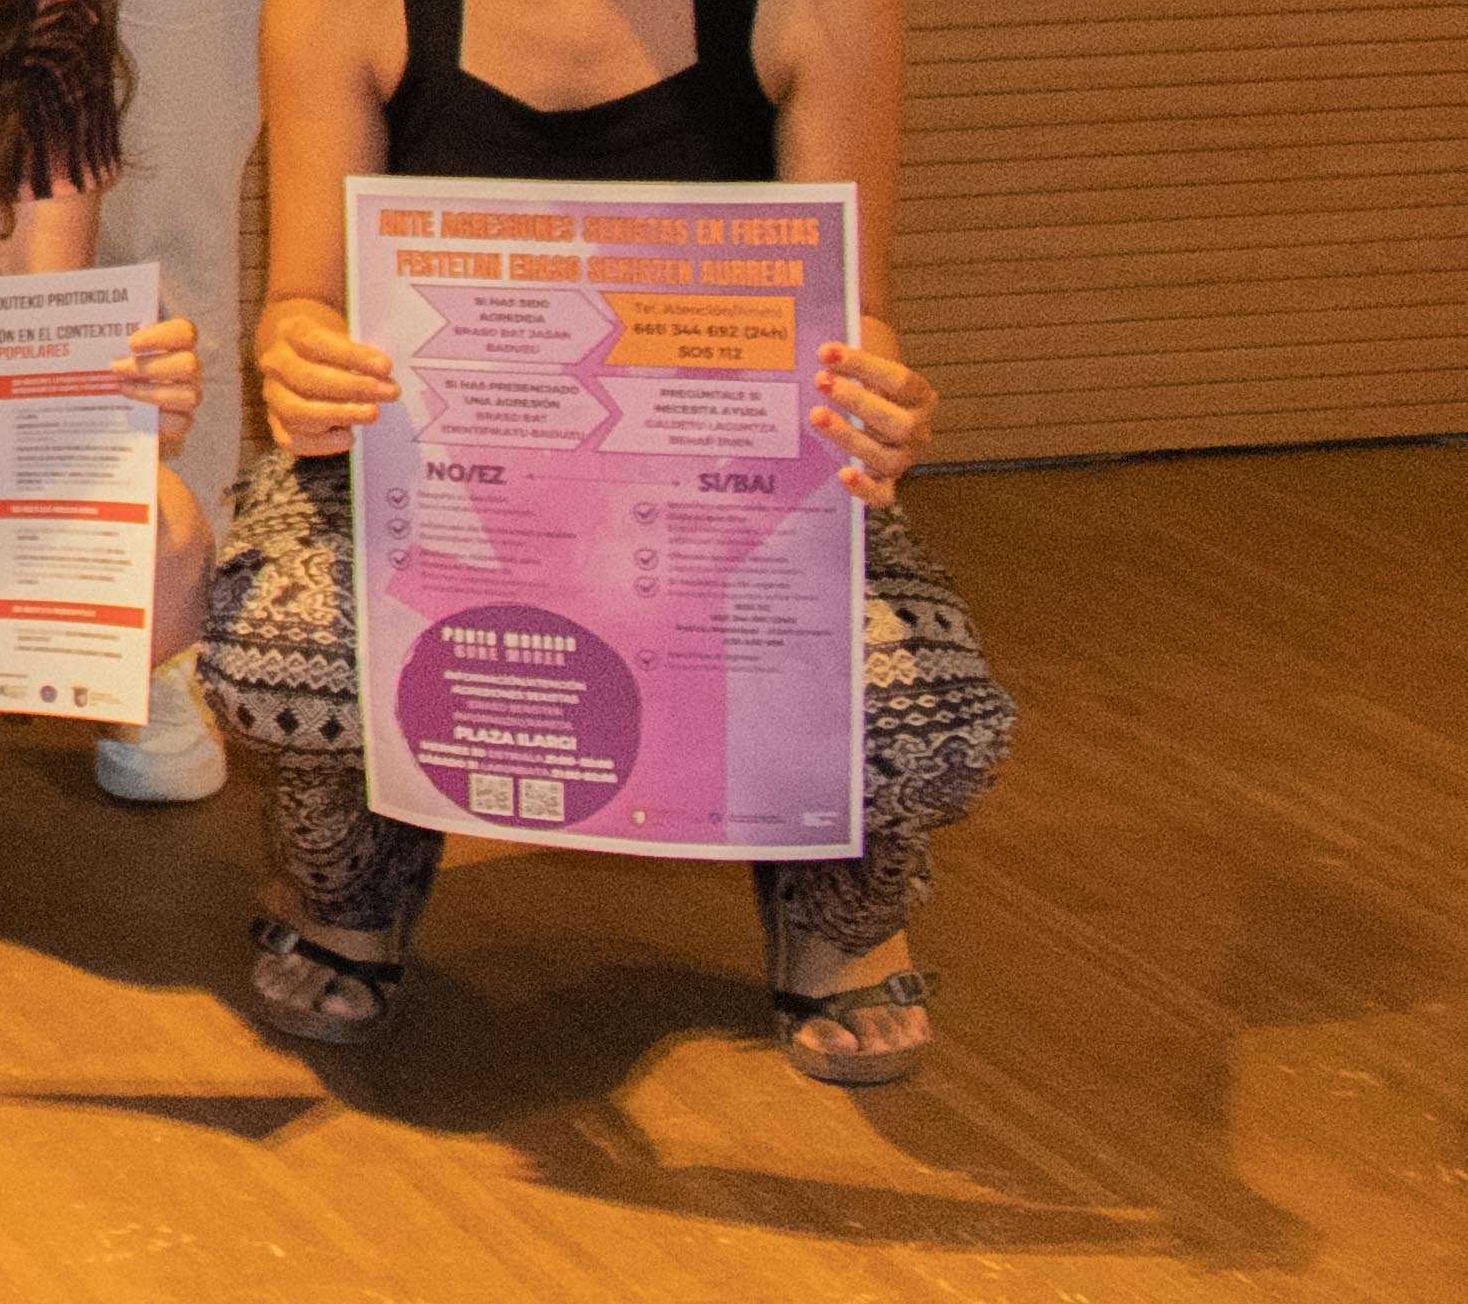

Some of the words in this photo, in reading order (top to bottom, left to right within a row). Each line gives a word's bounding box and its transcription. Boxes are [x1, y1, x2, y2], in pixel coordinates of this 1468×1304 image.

[379, 209, 435, 238] ANTE
[695, 218, 725, 246] EN
[730, 218, 820, 246] FIESTAS
[509, 252, 582, 282] ERASO
[47, 288, 128, 308] PROTOKOLOA
[18, 327, 35, 343] EN
[39, 326, 53, 341] EL
[56, 323, 123, 340] CONTEXTO
[678, 345, 714, 360] SOS
[426, 462, 507, 485] NO/EZ
[454, 725, 514, 745] PLAZA
